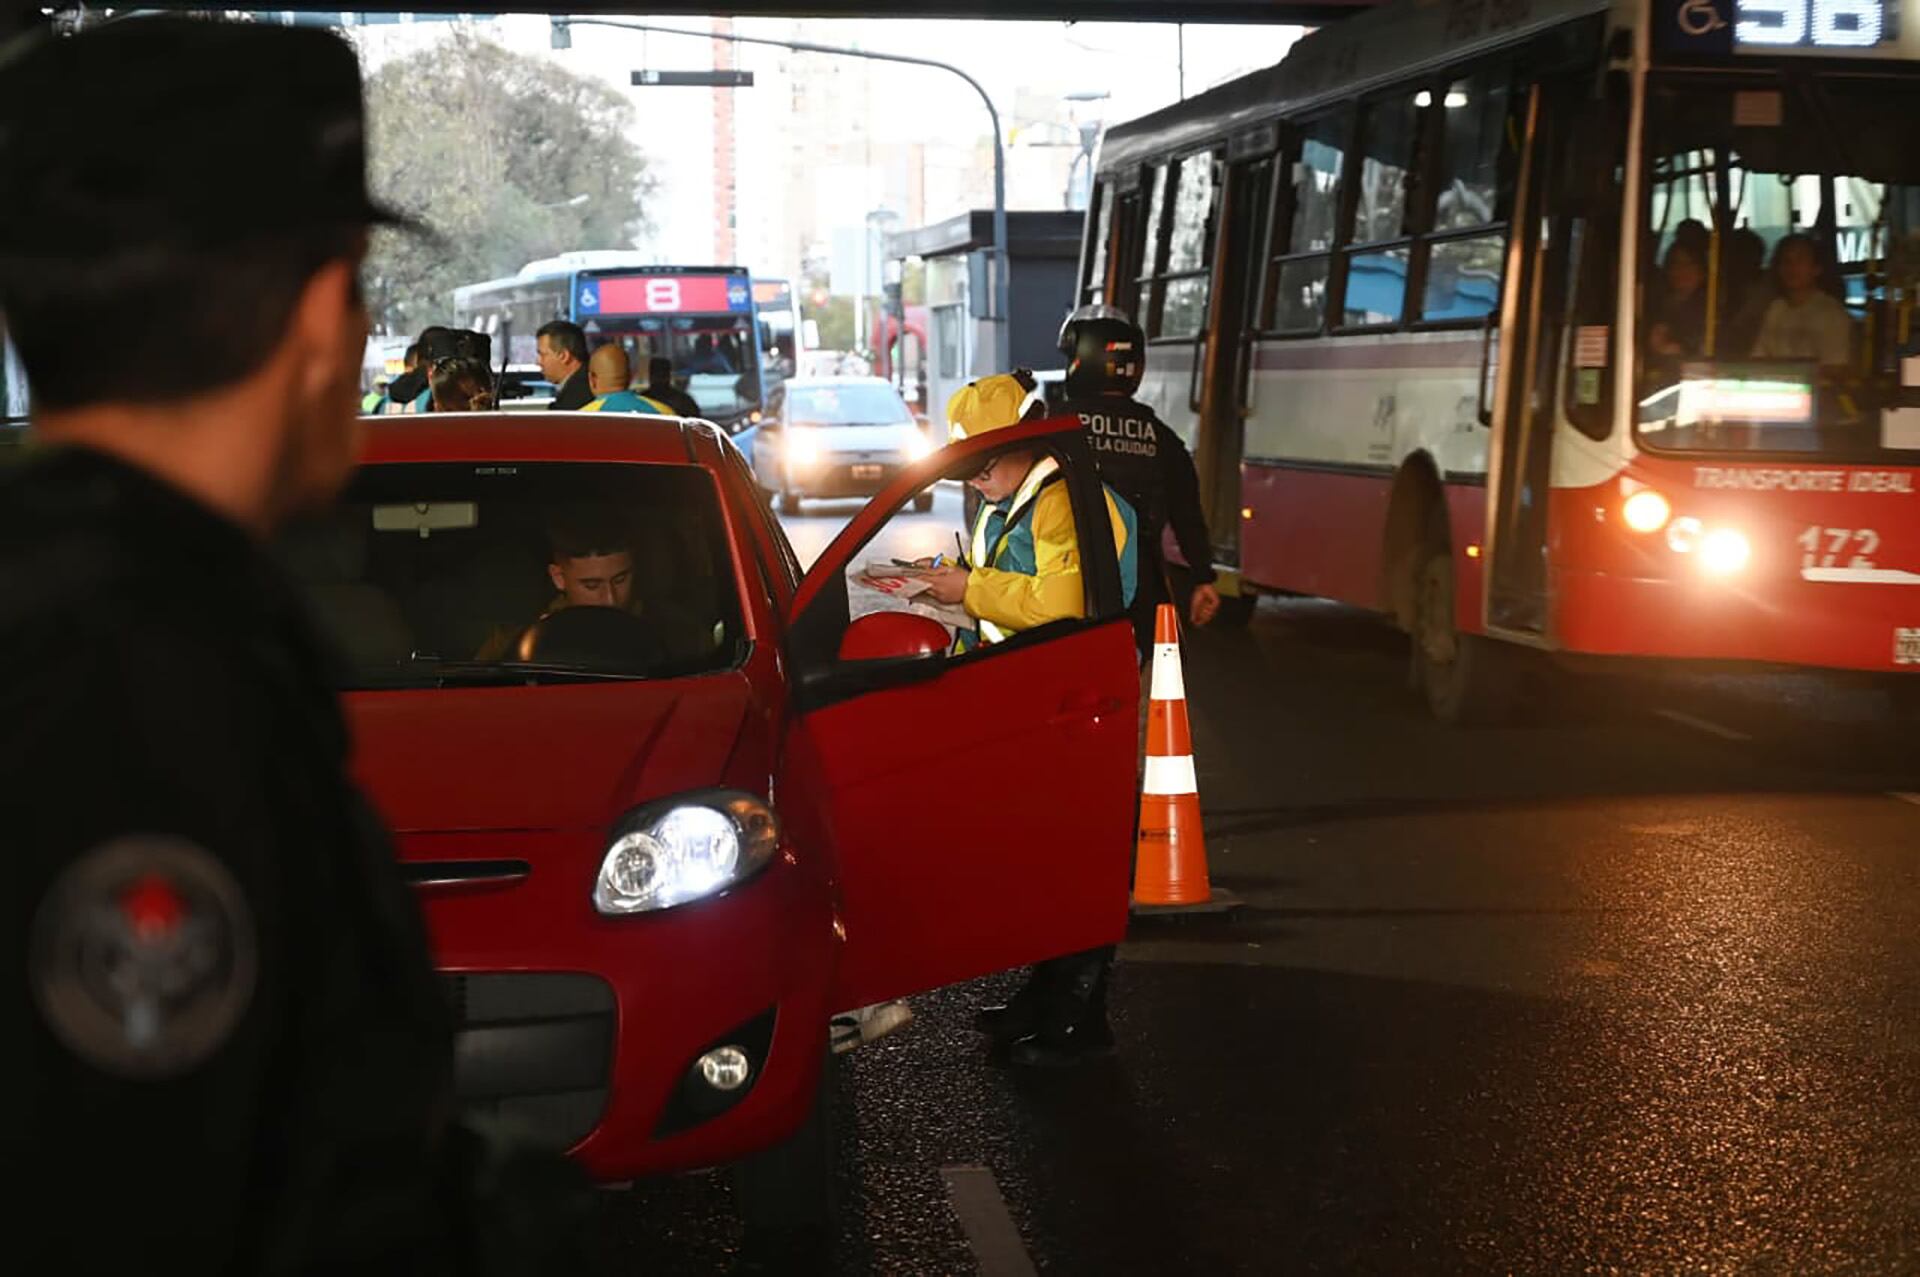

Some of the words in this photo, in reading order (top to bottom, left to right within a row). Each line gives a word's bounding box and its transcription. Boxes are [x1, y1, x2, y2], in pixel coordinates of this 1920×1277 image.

[646, 278, 682, 312] 8
[1078, 413, 1156, 441] POLICIA
[1096, 436, 1112, 453] LA
[1114, 439, 1157, 457] CIUDAD
[1693, 467, 1845, 492] TRANSPORTE
[1848, 471, 1914, 493] IDEAL
[1797, 525, 1879, 570] 172
